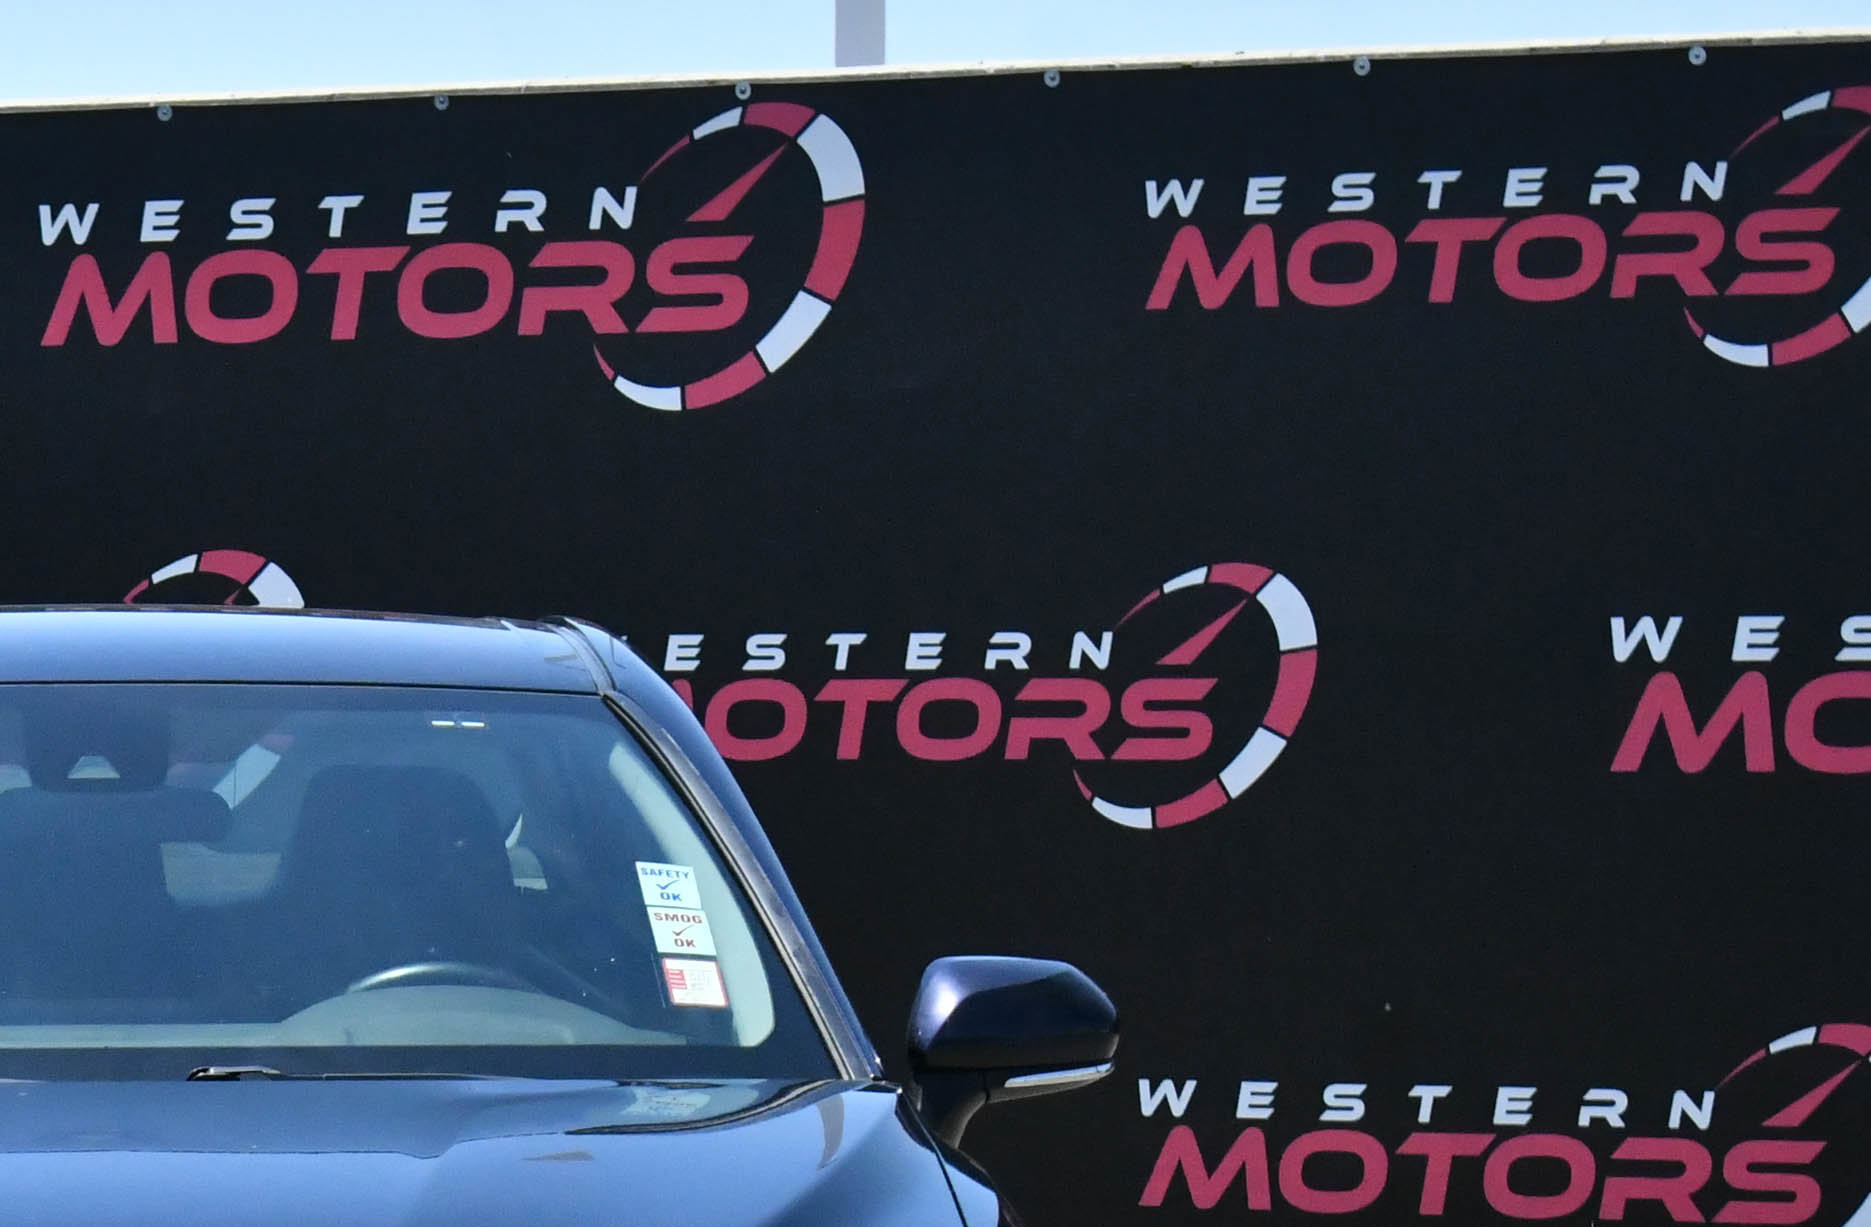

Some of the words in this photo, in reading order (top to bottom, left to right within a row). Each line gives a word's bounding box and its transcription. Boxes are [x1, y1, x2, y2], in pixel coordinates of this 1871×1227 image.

[39, 186, 637, 246] WESTERN
[1146, 162, 1727, 218] WESTERN
[1147, 208, 1838, 310] MOTORS
[42, 235, 753, 347] MOTORS
[664, 631, 1113, 671] ESTERN
[673, 677, 1216, 760] OTORS
[641, 867, 689, 879] SAFETY
[660, 892, 682, 901] OK
[654, 912, 703, 924] SMOG
[674, 938, 696, 947] OK
[1139, 1079, 1715, 1130] WESTERN
[1140, 1125, 1825, 1224] MOTORS
